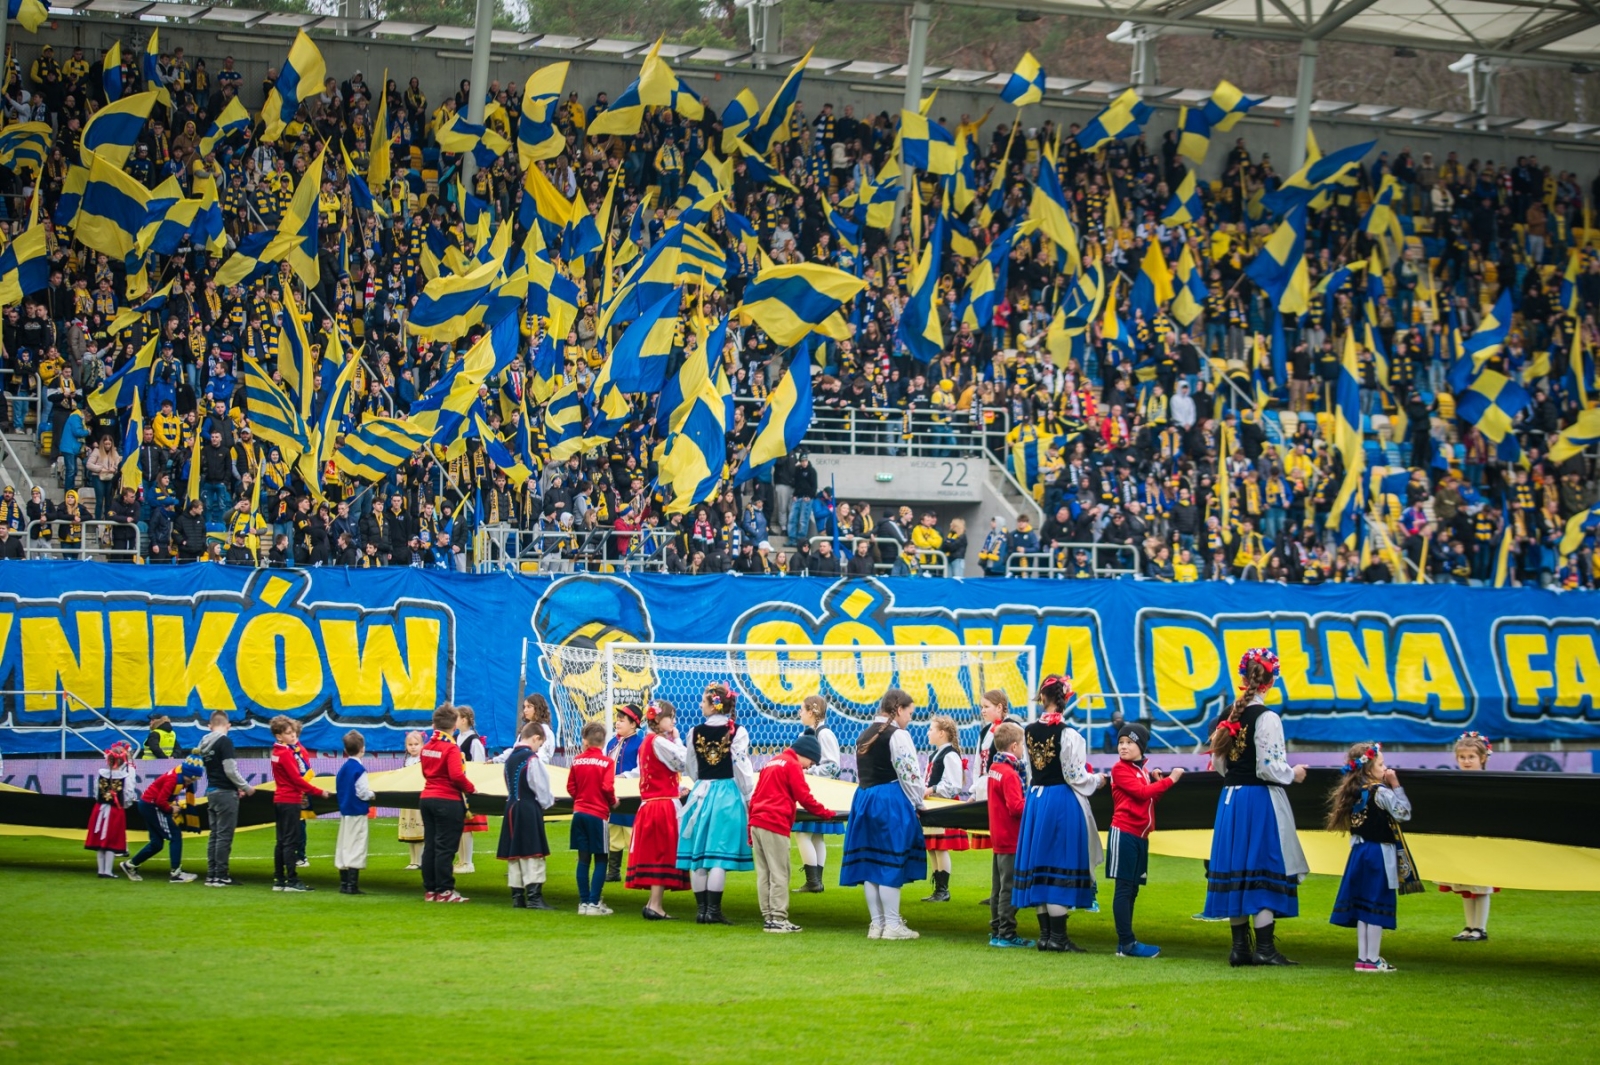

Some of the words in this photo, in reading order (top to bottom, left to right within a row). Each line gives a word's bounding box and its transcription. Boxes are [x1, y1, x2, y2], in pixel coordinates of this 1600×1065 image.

[941, 461, 968, 487] 22
[746, 588, 1106, 709] GÓRKA
[1151, 625, 1465, 711] PEŁNA
[1504, 633, 1600, 708] FA
